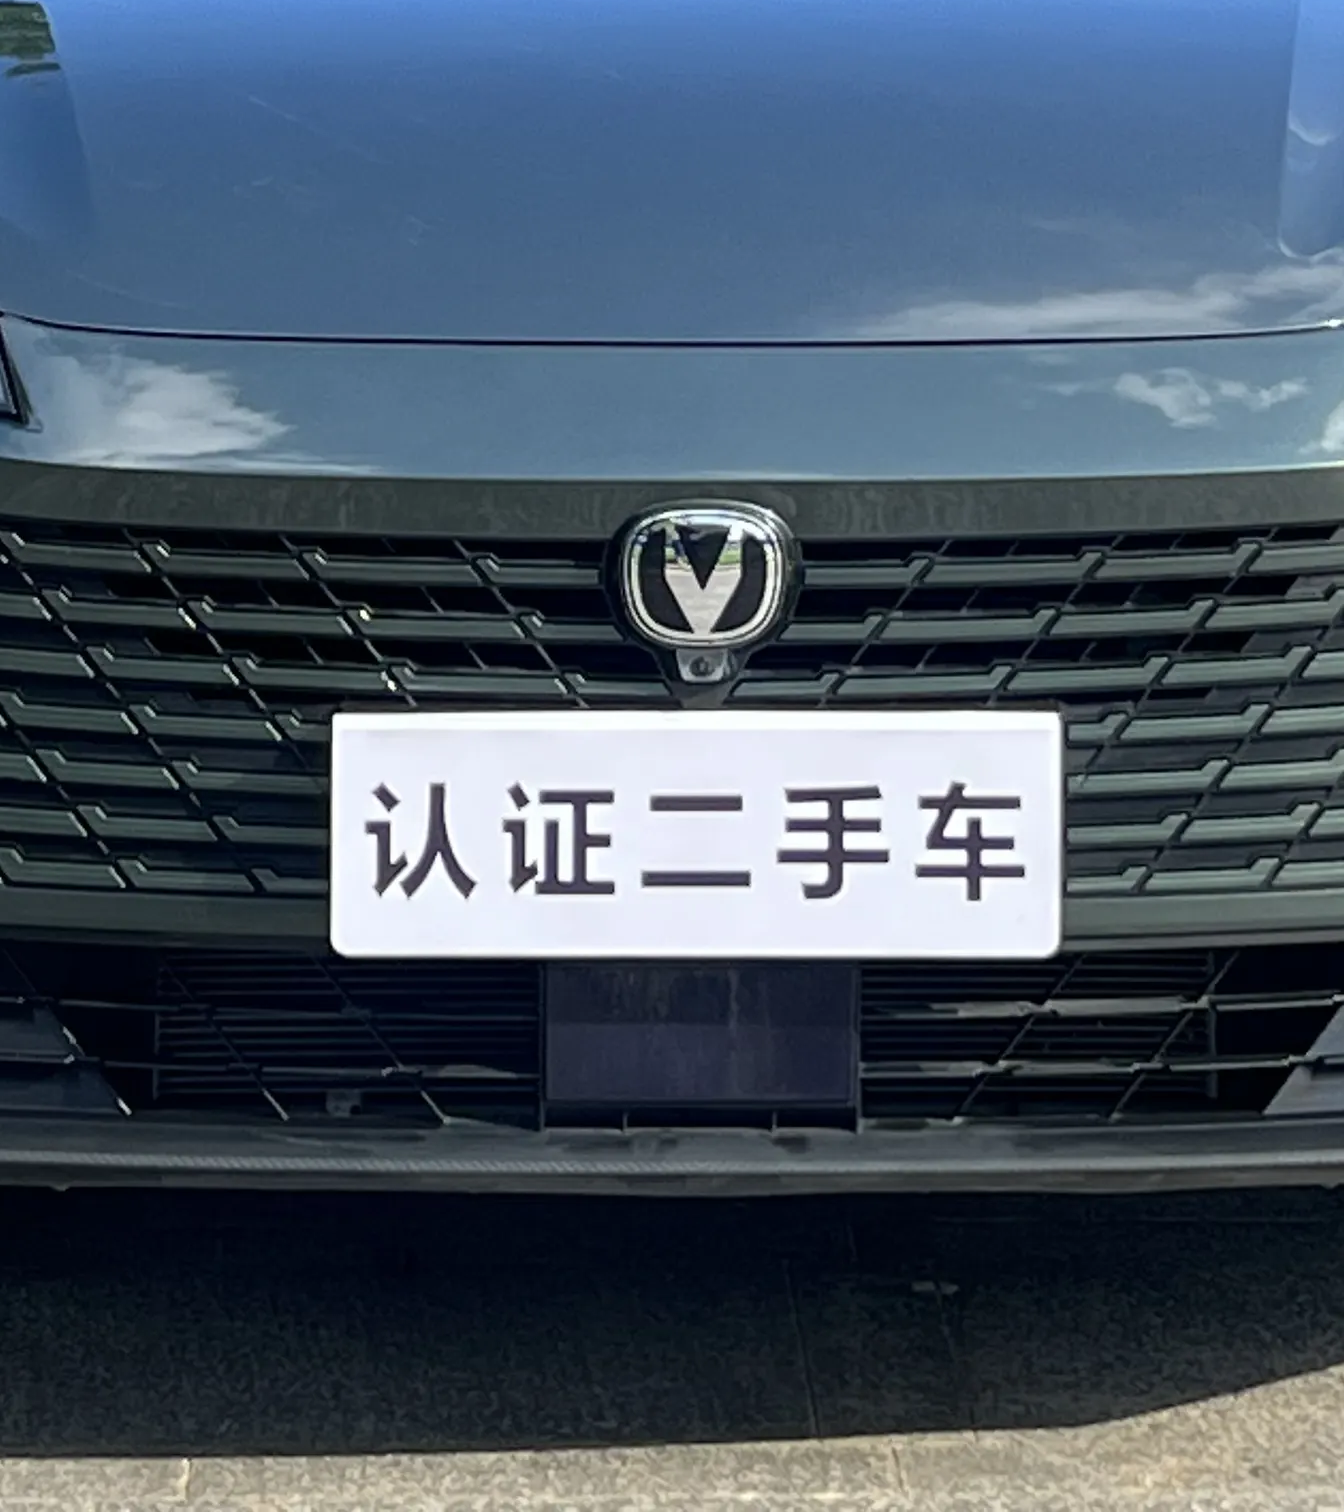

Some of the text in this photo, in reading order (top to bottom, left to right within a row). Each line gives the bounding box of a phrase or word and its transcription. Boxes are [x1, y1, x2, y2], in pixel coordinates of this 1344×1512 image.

[364, 780, 1026, 902] 认证二手车
